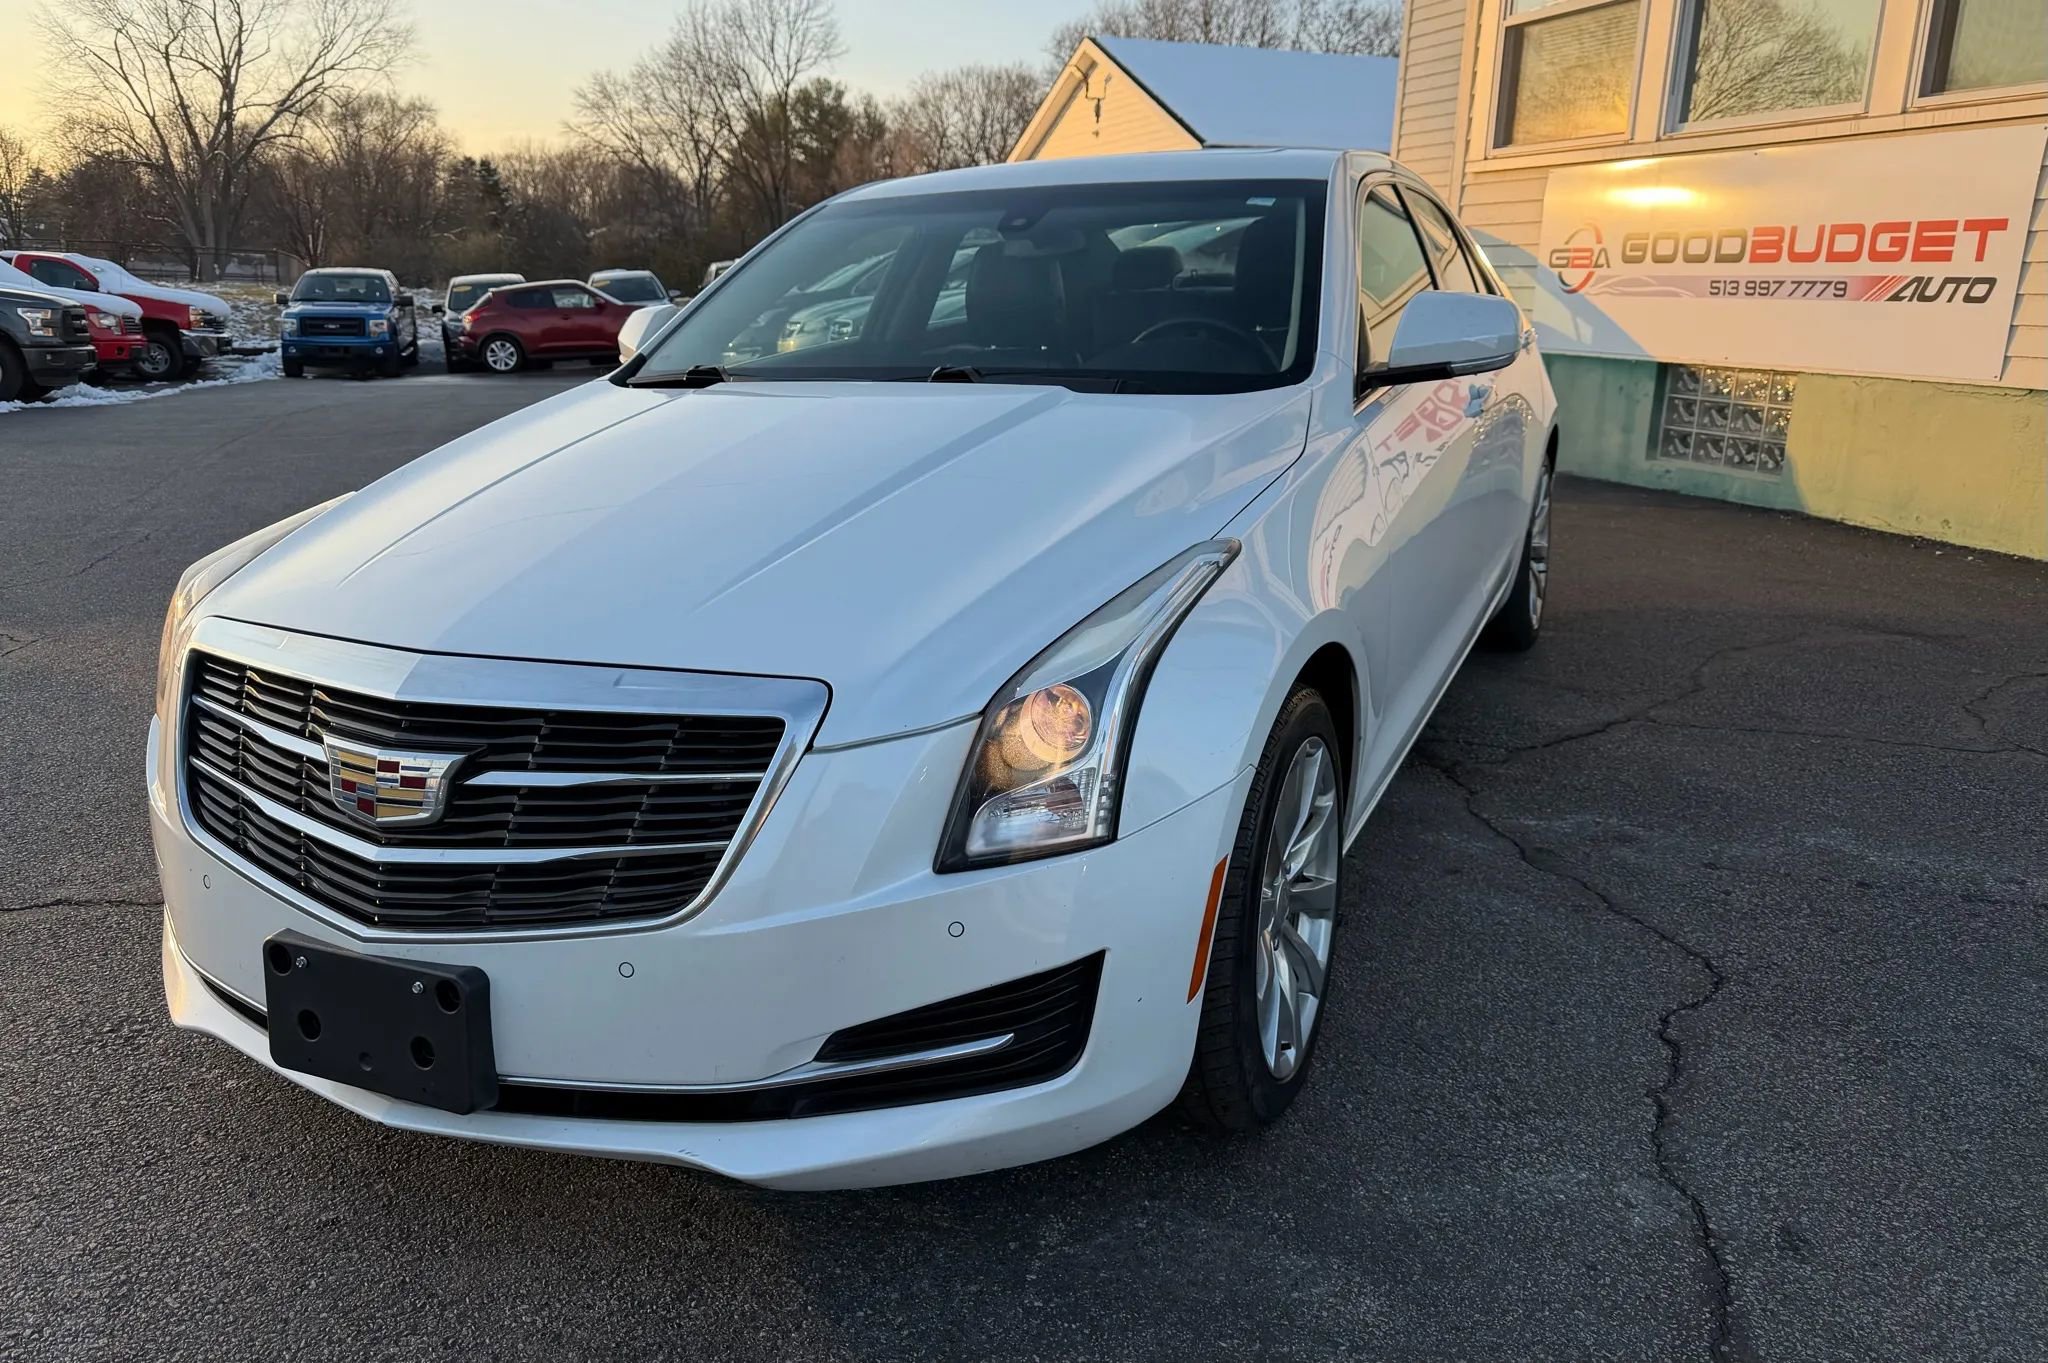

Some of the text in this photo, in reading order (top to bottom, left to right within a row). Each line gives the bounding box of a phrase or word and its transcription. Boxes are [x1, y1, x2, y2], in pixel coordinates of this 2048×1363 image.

[1549, 247, 1611, 269] GBA
[1709, 280, 1848, 298] 513 997 7779
[1884, 276, 1997, 304] AUTO
